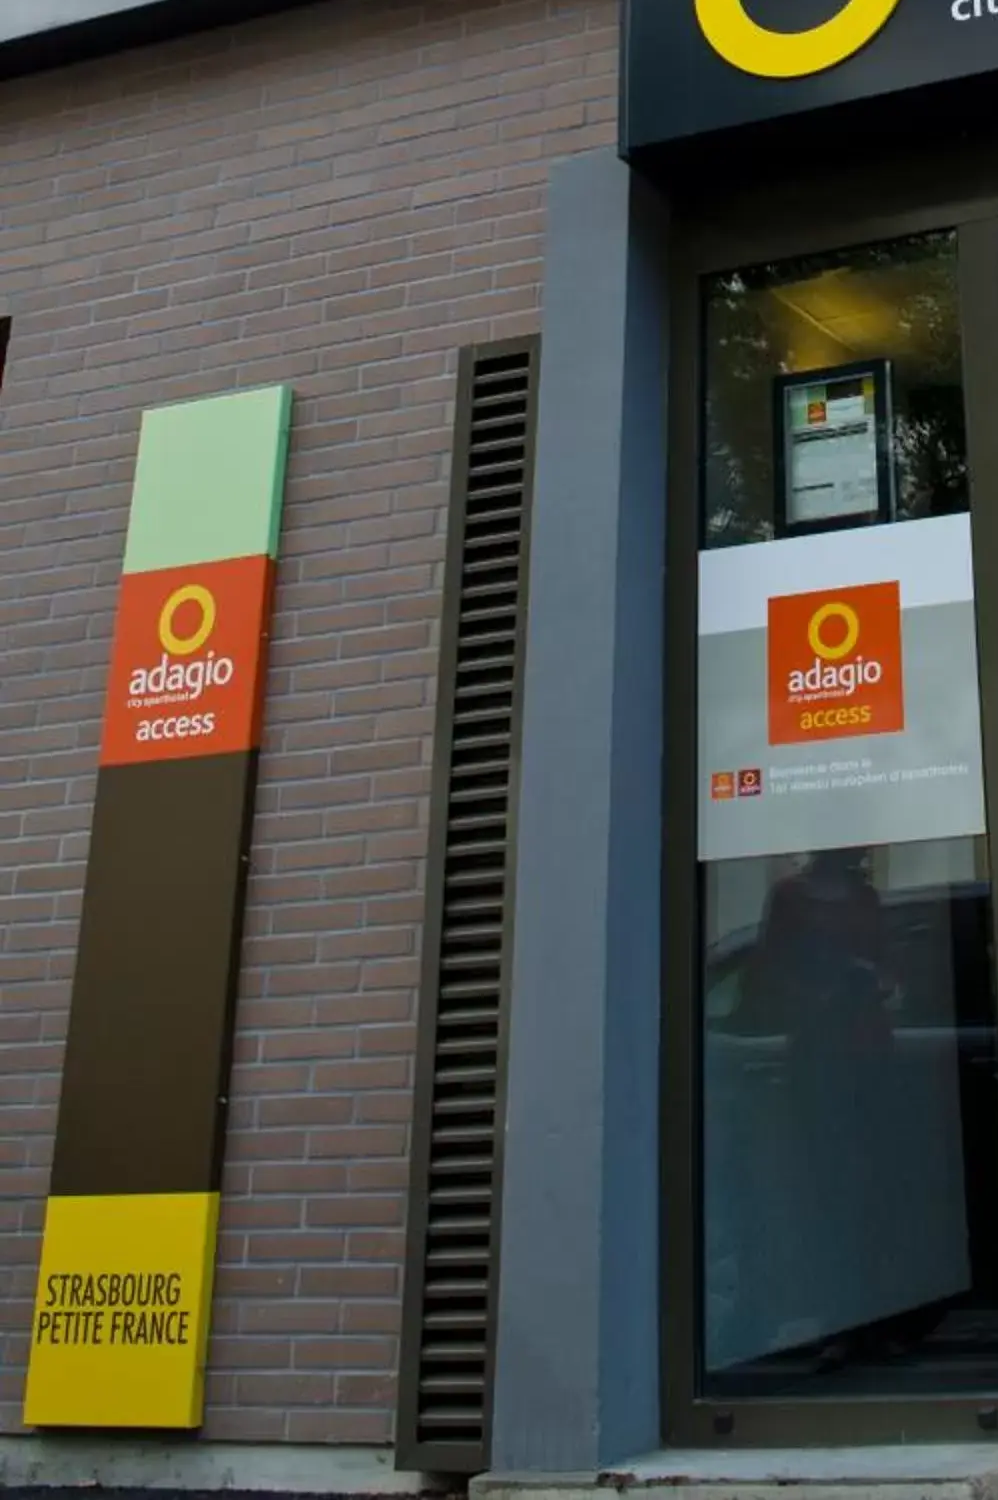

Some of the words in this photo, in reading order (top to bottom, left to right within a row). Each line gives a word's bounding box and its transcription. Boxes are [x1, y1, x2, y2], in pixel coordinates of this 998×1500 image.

[128, 650, 234, 700] adagio
[787, 655, 882, 696] adagio
[135, 712, 216, 741] access
[800, 704, 872, 730] access
[45, 1273, 182, 1307] STRASBOURG
[36, 1310, 104, 1345] PETITE
[109, 1310, 191, 1345] FRANCE
